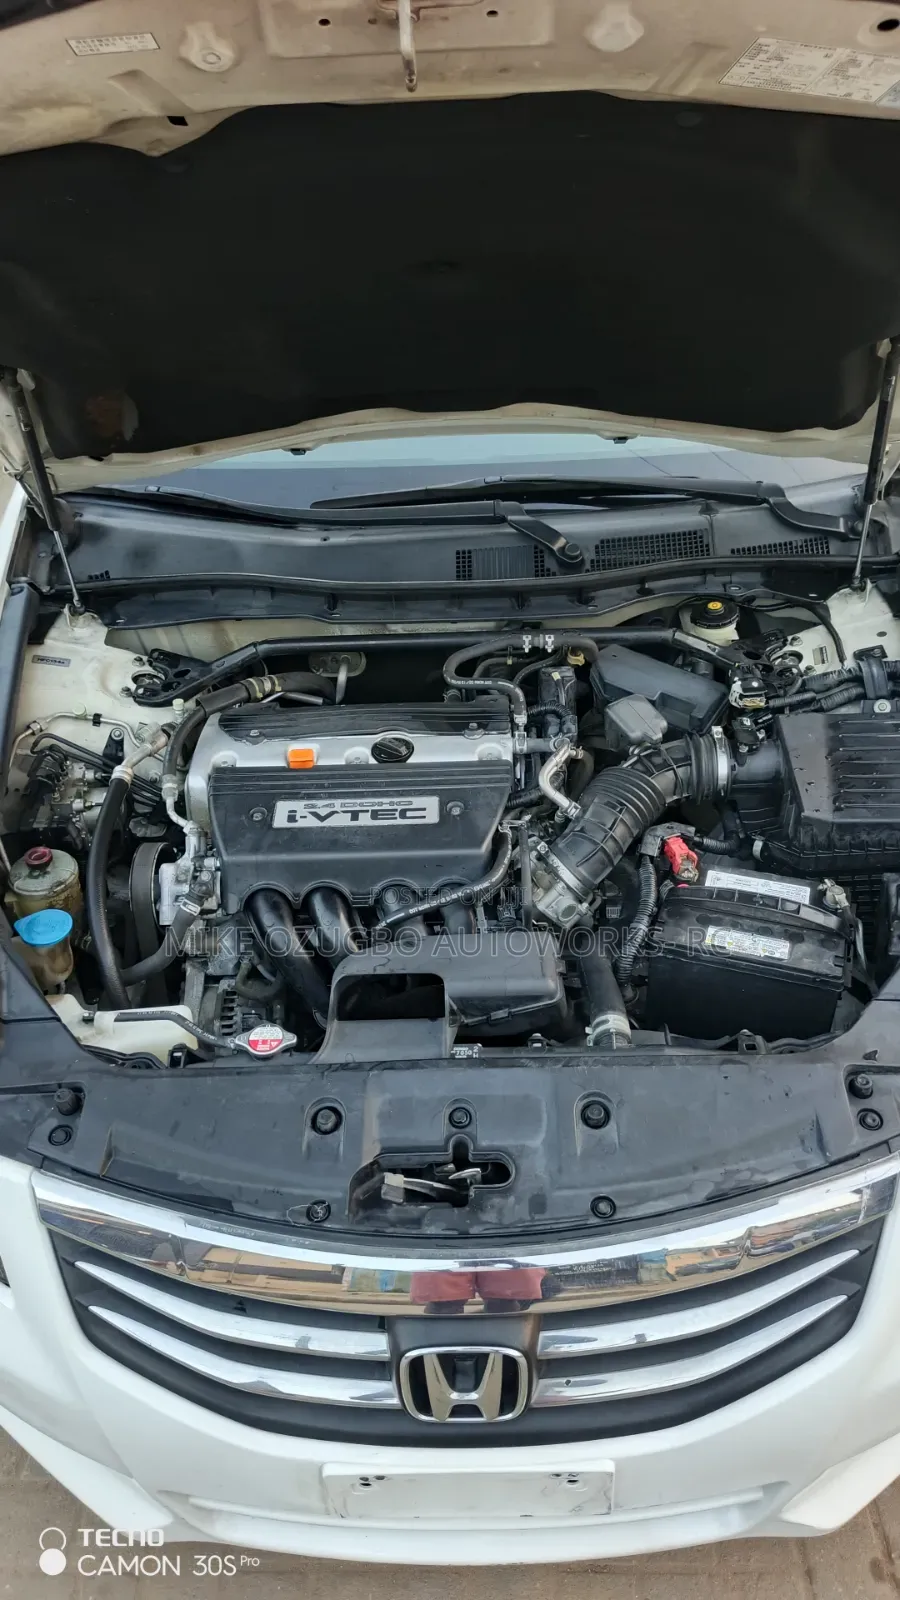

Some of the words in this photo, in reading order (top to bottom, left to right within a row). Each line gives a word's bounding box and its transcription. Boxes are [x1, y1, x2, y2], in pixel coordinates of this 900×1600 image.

[303, 802, 336, 810] 2.4
[340, 800, 413, 808] DOHC
[287, 807, 427, 824] i-VTEC
